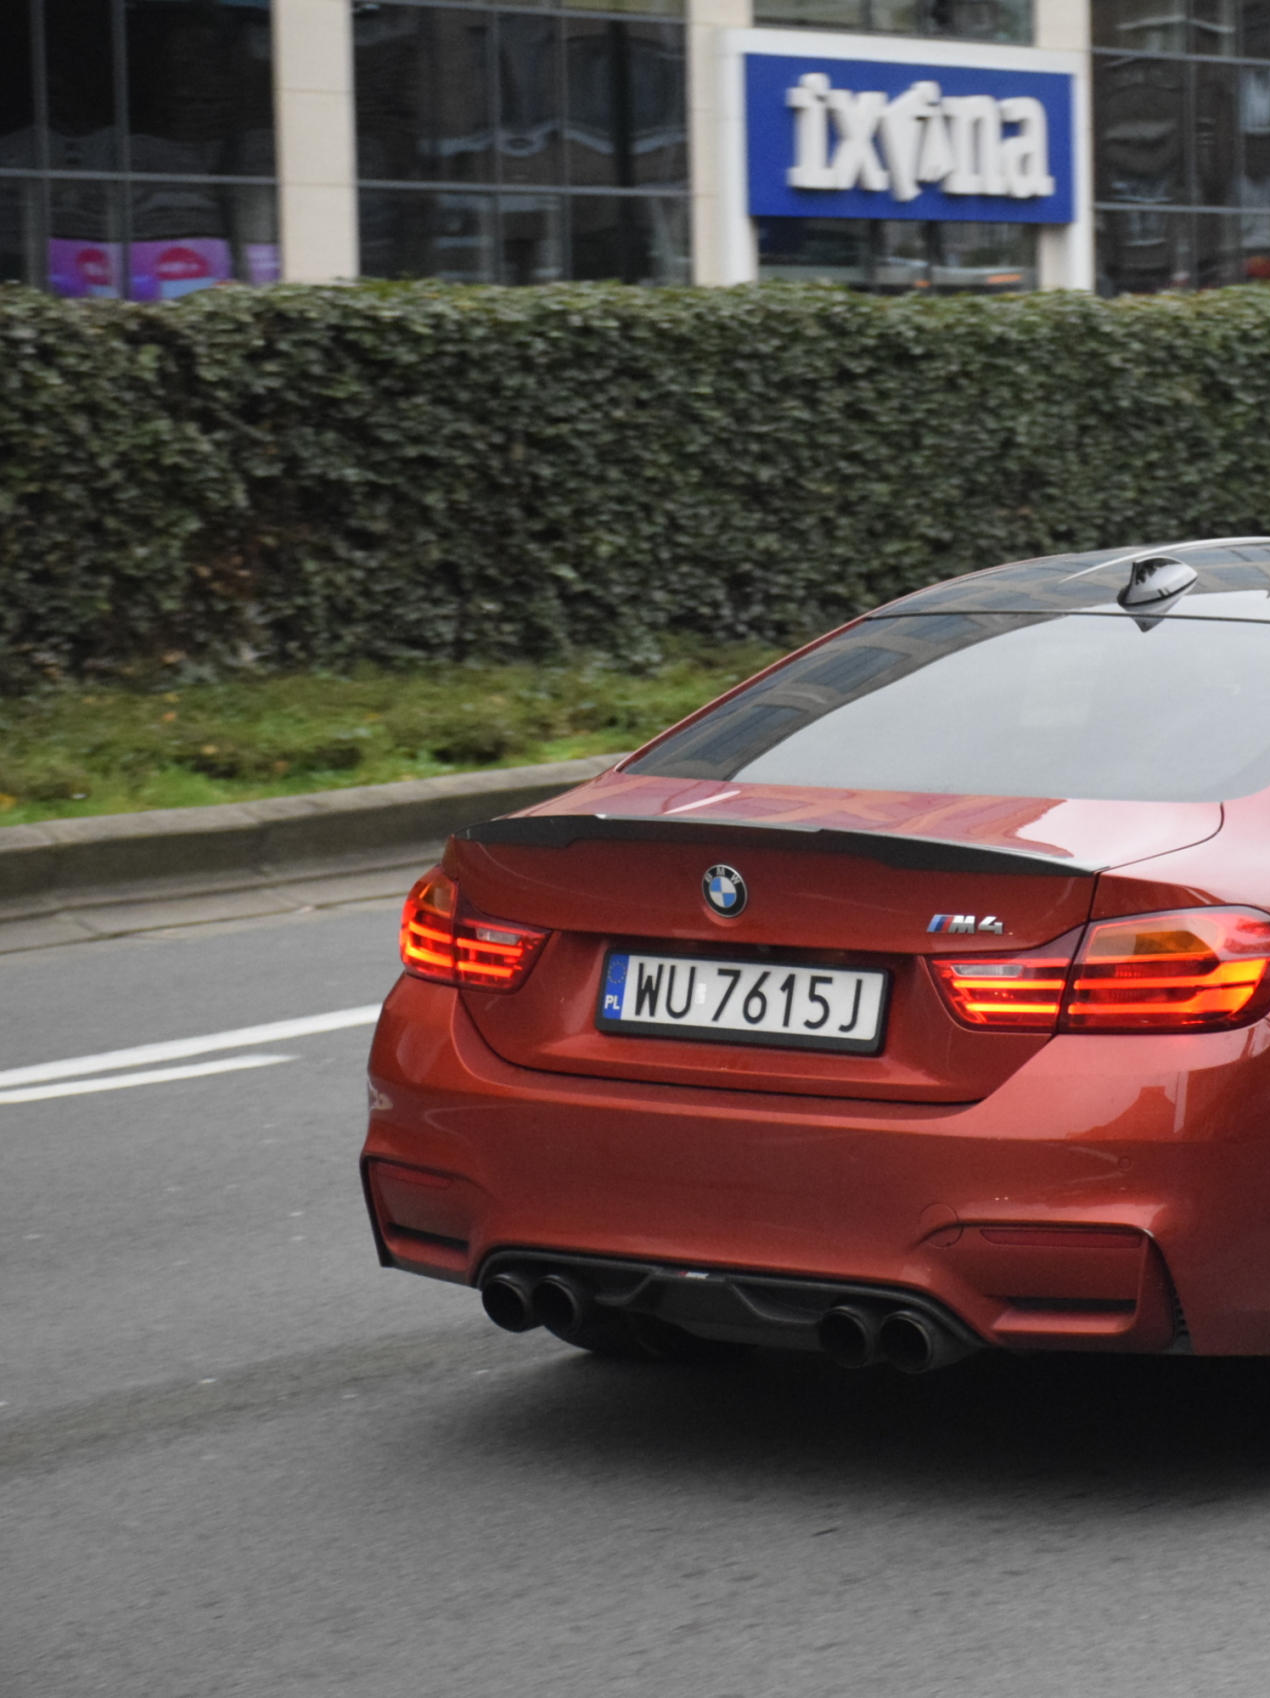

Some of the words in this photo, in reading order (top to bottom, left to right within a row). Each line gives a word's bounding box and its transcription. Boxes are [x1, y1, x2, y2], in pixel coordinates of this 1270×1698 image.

[704, 867, 741, 885] BMW
[946, 914, 1003, 935] M4
[604, 995, 620, 1010] PL
[634, 962, 697, 1020] WU
[711, 968, 863, 1033] 7615J
